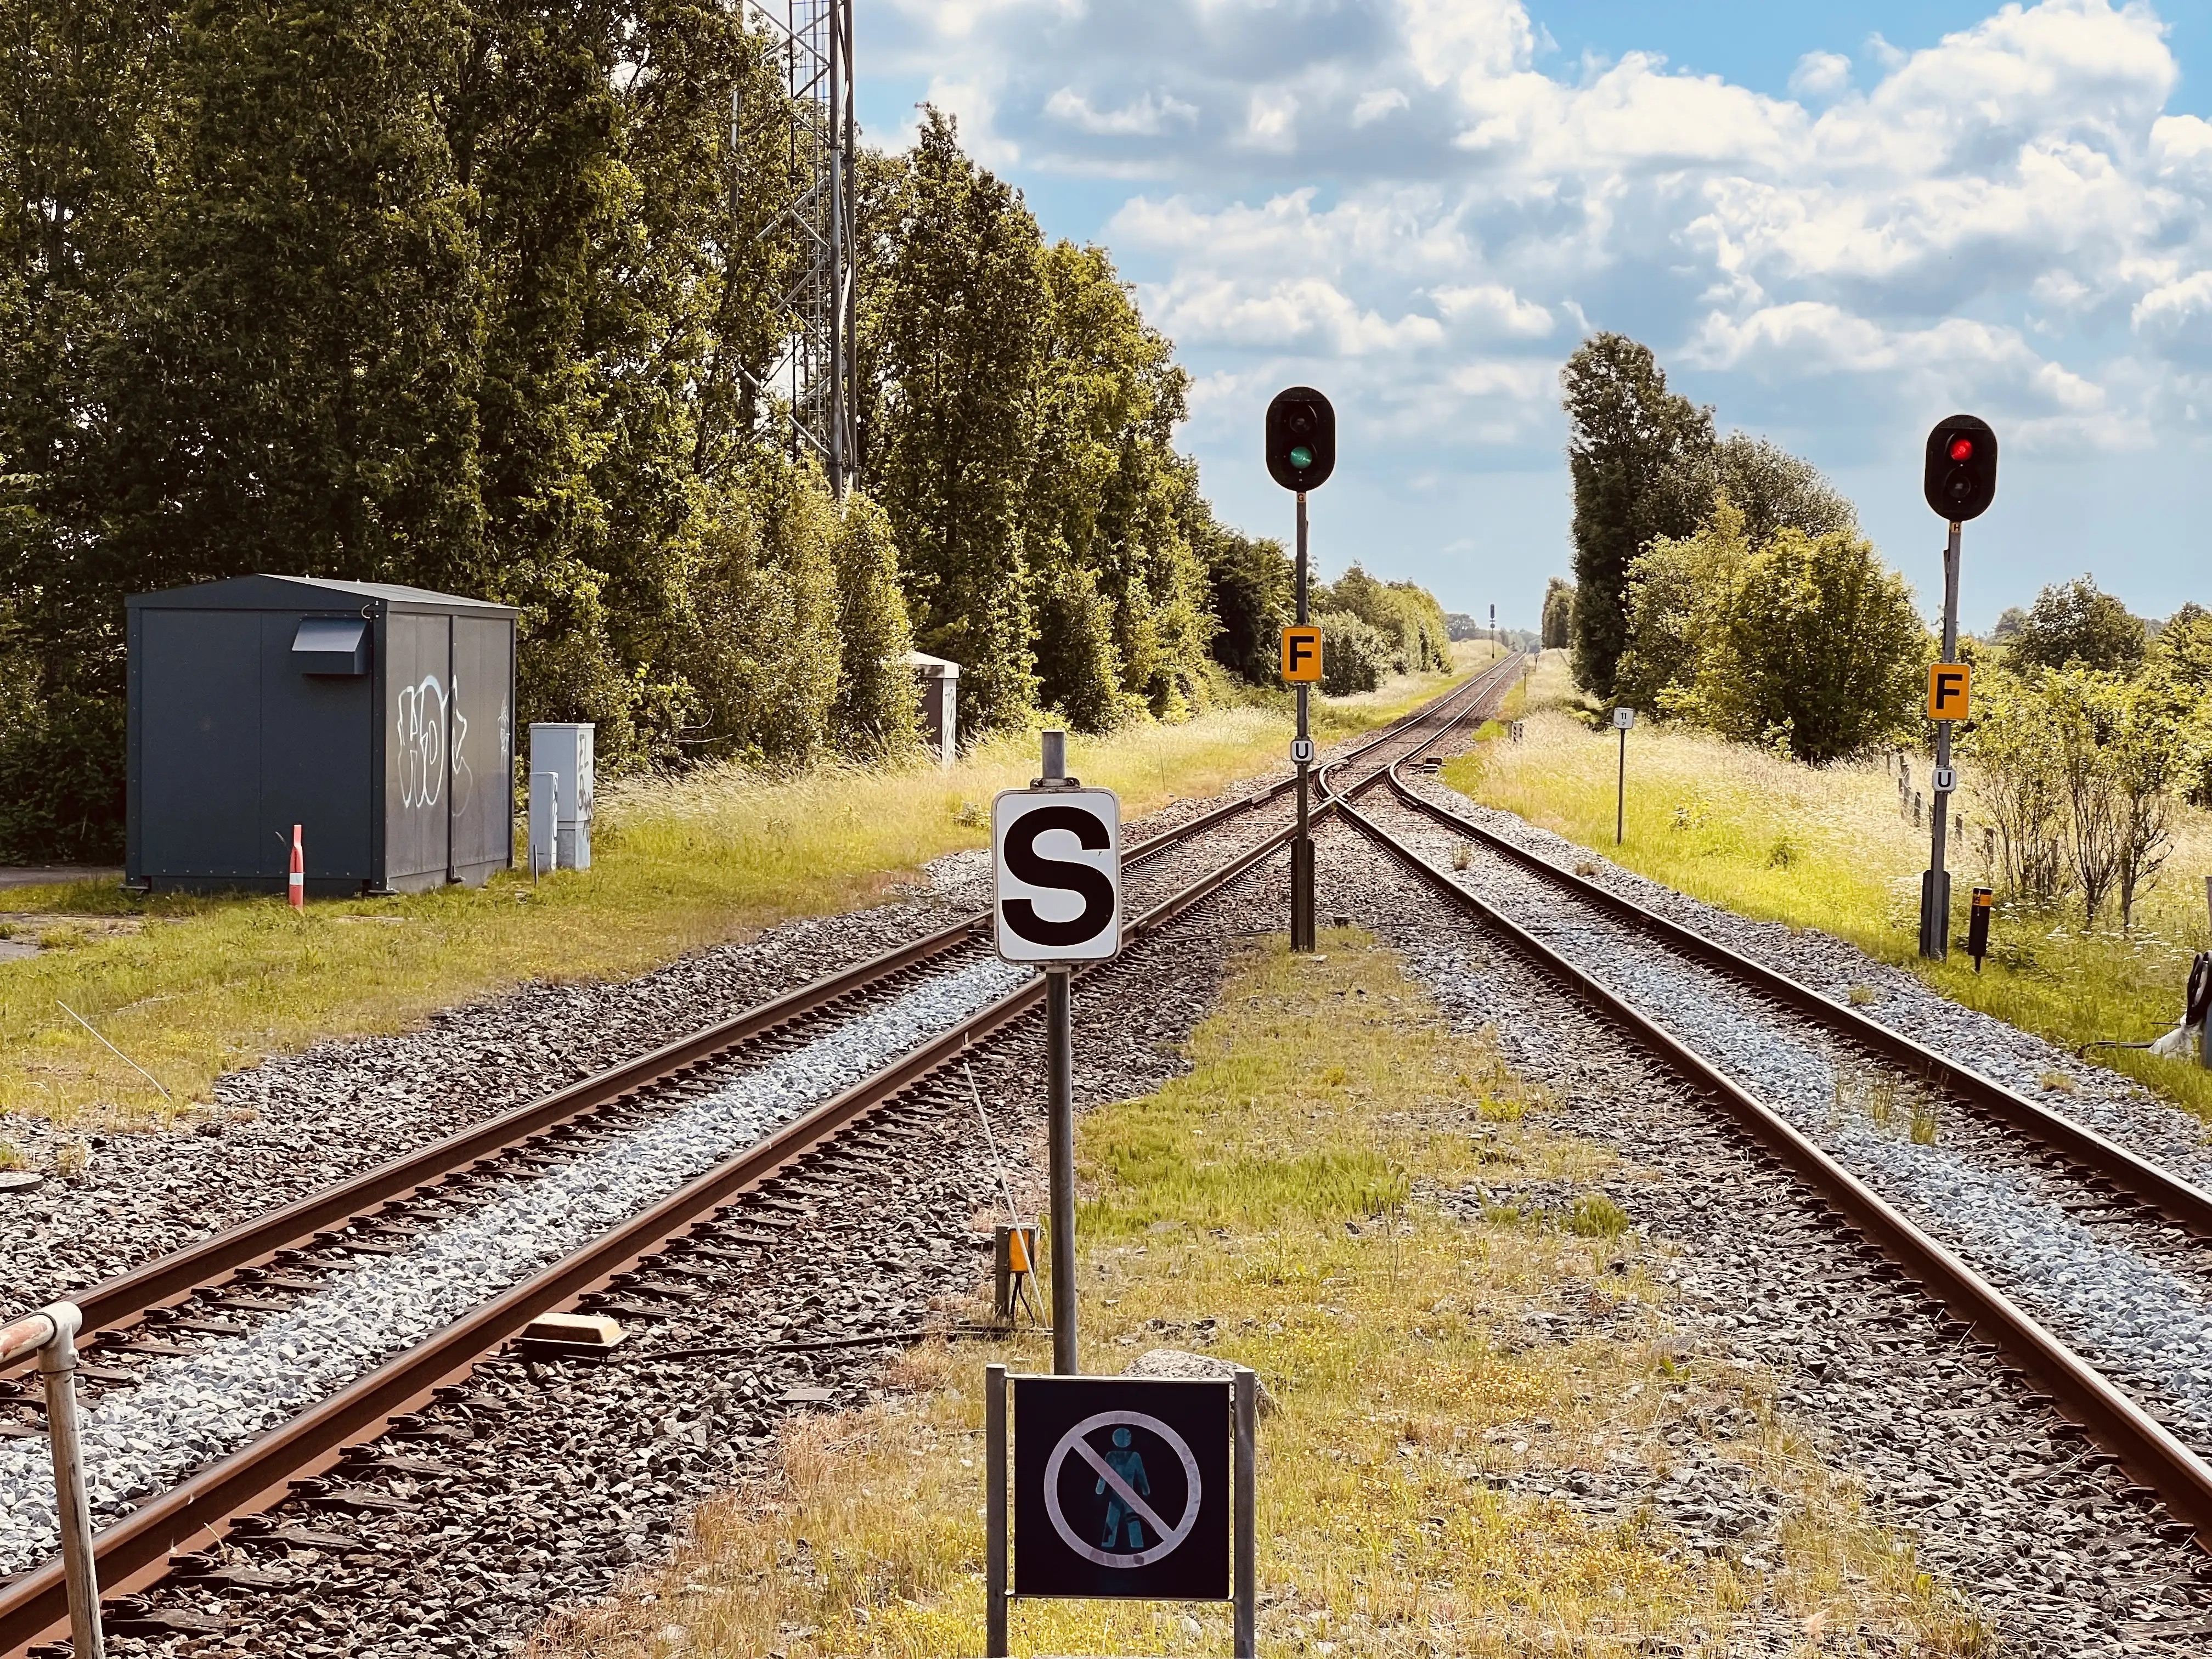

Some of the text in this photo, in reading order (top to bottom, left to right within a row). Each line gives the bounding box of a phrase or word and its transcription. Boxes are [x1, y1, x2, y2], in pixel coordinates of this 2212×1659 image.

[1289, 636, 1314, 672] F
[1936, 673, 1963, 709] F
[1295, 743, 1308, 759] U
[1938, 771, 1951, 788] U
[1001, 806, 1115, 946] S
